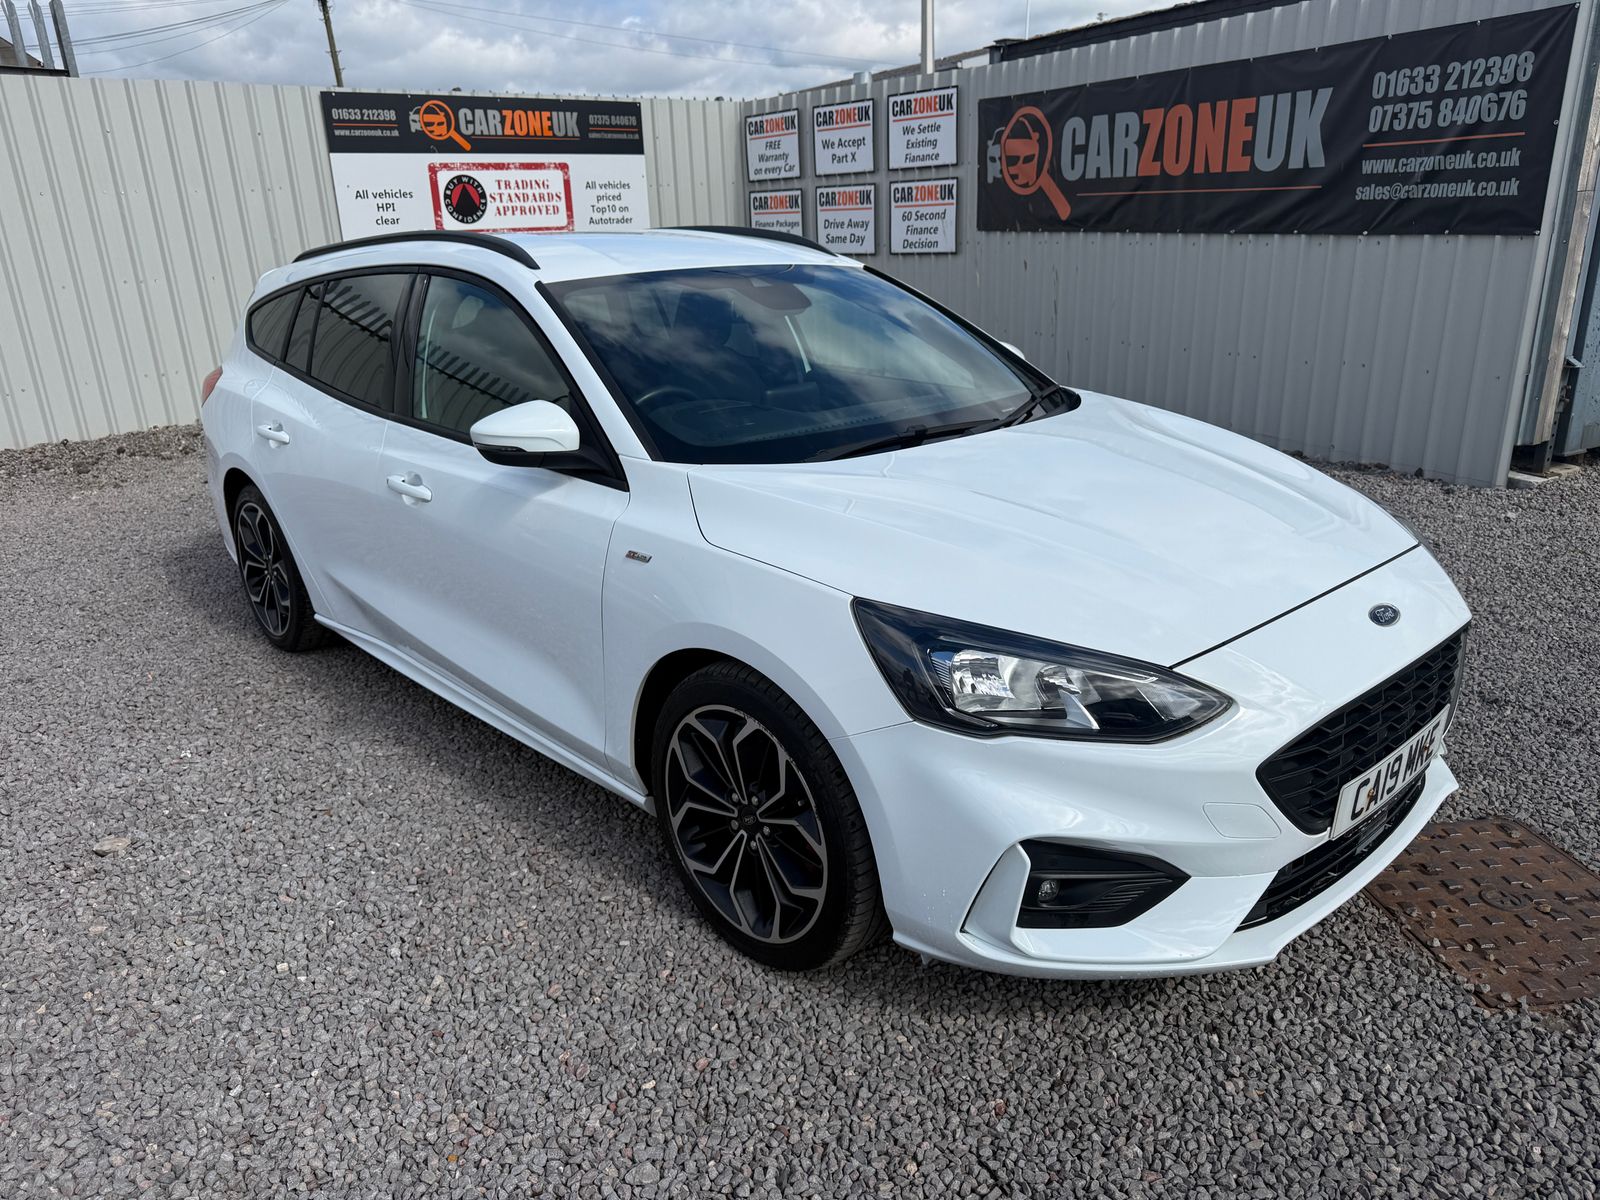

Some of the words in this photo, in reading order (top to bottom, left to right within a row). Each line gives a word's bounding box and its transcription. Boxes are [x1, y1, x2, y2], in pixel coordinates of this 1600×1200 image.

[1371, 64, 1441, 100] 01633
[1444, 51, 1536, 92] 212398
[892, 93, 954, 118] CARZONEUK
[1368, 100, 1433, 133] 07375
[1437, 89, 1528, 127] 840676
[331, 107, 362, 120] 01633
[362, 109, 397, 121] 212398
[588, 114, 611, 126] 07375
[816, 105, 871, 128] CARZONEUK
[458, 107, 580, 137] CARZONEUK
[748, 114, 797, 136] CARZONEUK
[902, 125, 916, 136] We
[917, 122, 942, 135] Settle
[1060, 87, 1334, 181] CARZONEUK
[765, 139, 782, 151] FREE
[821, 139, 836, 150] We
[837, 136, 867, 150] Accept
[906, 137, 938, 150] Existing
[758, 152, 790, 163] Warranty
[831, 152, 849, 164] Part
[850, 151, 857, 163] X
[904, 152, 940, 164] Fianance
[1361, 147, 1522, 175] www.carzoneuk.co.uk
[753, 168, 763, 176] on
[763, 166, 783, 176] every
[783, 162, 796, 173] Car
[445, 177, 459, 196] BUY
[461, 176, 484, 194] WITH
[495, 178, 551, 191] TRADING
[585, 180, 597, 190] All
[598, 180, 631, 190] vehicles
[1354, 177, 1520, 201] sales@carzoneuk.co.uk
[355, 189, 369, 200] All
[371, 188, 414, 200] vehicles
[488, 191, 563, 204] STANDARDS
[596, 192, 622, 204] priced
[818, 189, 872, 207] CARZONEUK
[893, 183, 955, 204] CARZONEUK
[376, 202, 396, 212] HPI
[590, 204, 617, 215] Top10
[752, 194, 800, 211] CARZONEUK
[445, 198, 487, 223] CONFIDENCE
[494, 204, 560, 217] APPROVED
[901, 210, 913, 222] 60
[914, 207, 947, 221] Second
[375, 215, 401, 226] clear
[589, 215, 633, 225] Autotrader
[823, 218, 845, 230] Drive
[846, 217, 870, 232] Away
[905, 224, 939, 236] Finance
[825, 233, 848, 245] Same
[849, 233, 866, 247] Day
[902, 238, 939, 250] Decision
[1350, 753, 1404, 821] CA19
